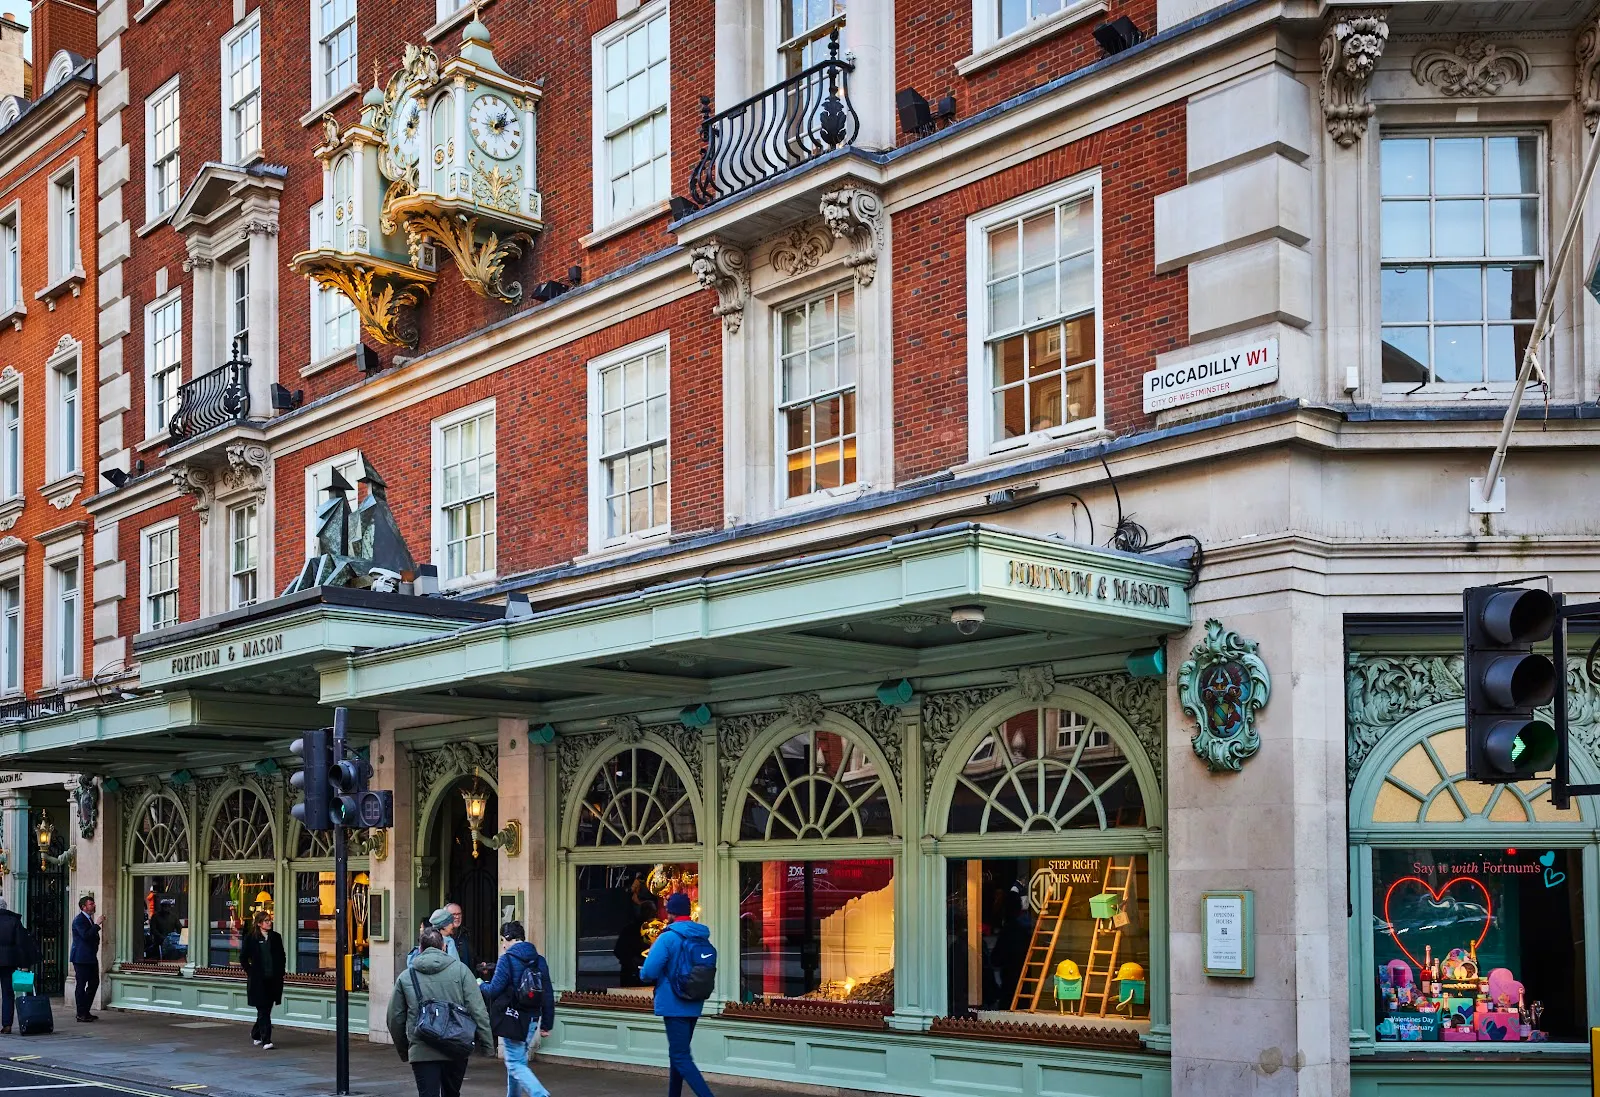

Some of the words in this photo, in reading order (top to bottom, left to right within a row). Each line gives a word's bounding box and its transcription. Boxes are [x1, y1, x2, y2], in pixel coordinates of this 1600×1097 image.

[1151, 354, 1241, 391] PICCADILLY
[1246, 347, 1268, 367] W1
[1151, 397, 1166, 408] CITY
[1168, 395, 1178, 403] OF
[1180, 382, 1230, 401] WESTMINSTER
[1008, 560, 1093, 597] FORTNUM
[1097, 576, 1107, 600] &
[1113, 578, 1170, 609] MASON
[171, 649, 220, 674] FORTNUM
[228, 645, 235, 662] &
[243, 634, 282, 658] MASON
[1048, 859, 1071, 870] STEP
[1072, 859, 1100, 871] RIGHT
[1413, 862, 1434, 876] Say
[1438, 862, 1448, 874] it
[1451, 862, 1479, 874] with
[1482, 861, 1541, 874] Fortnum's
[1049, 873, 1070, 883] THIS
[1071, 873, 1091, 883] WAY
[1422, 1016, 1435, 1024] Day
